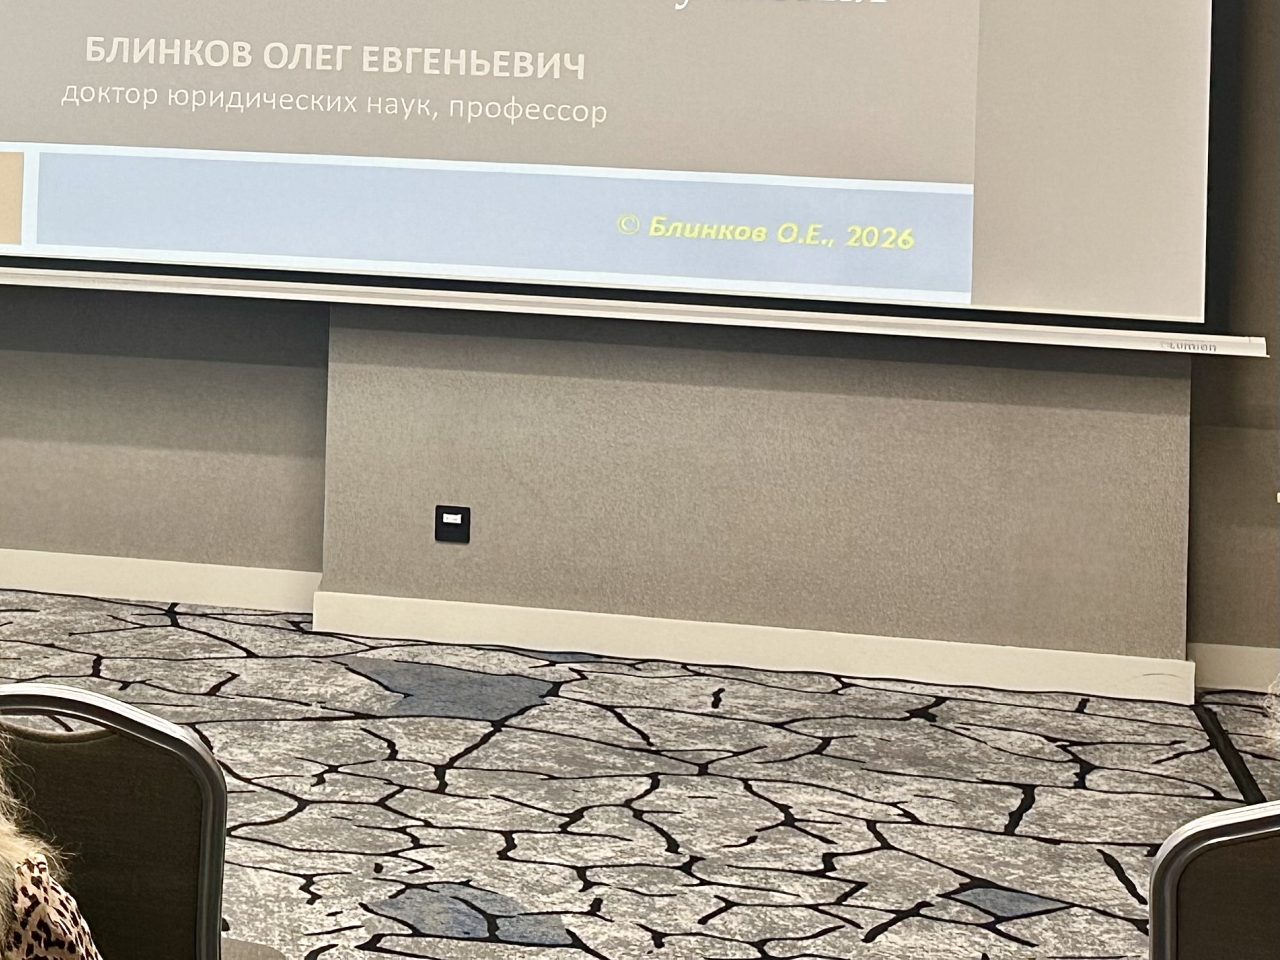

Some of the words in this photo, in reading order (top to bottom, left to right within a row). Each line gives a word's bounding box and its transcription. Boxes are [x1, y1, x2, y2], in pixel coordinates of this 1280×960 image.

[85, 35, 254, 68] БЛИНКОВ
[263, 41, 354, 71] ОЛЕГ
[362, 45, 587, 80] ЕВГЕНЬЕВИЧ
[60, 83, 159, 107] доктор
[167, 88, 358, 114] юридических
[366, 96, 439, 120] наук,
[449, 97, 608, 127] профессор
[648, 215, 769, 243] Блинков
[846, 224, 916, 251] 2026
